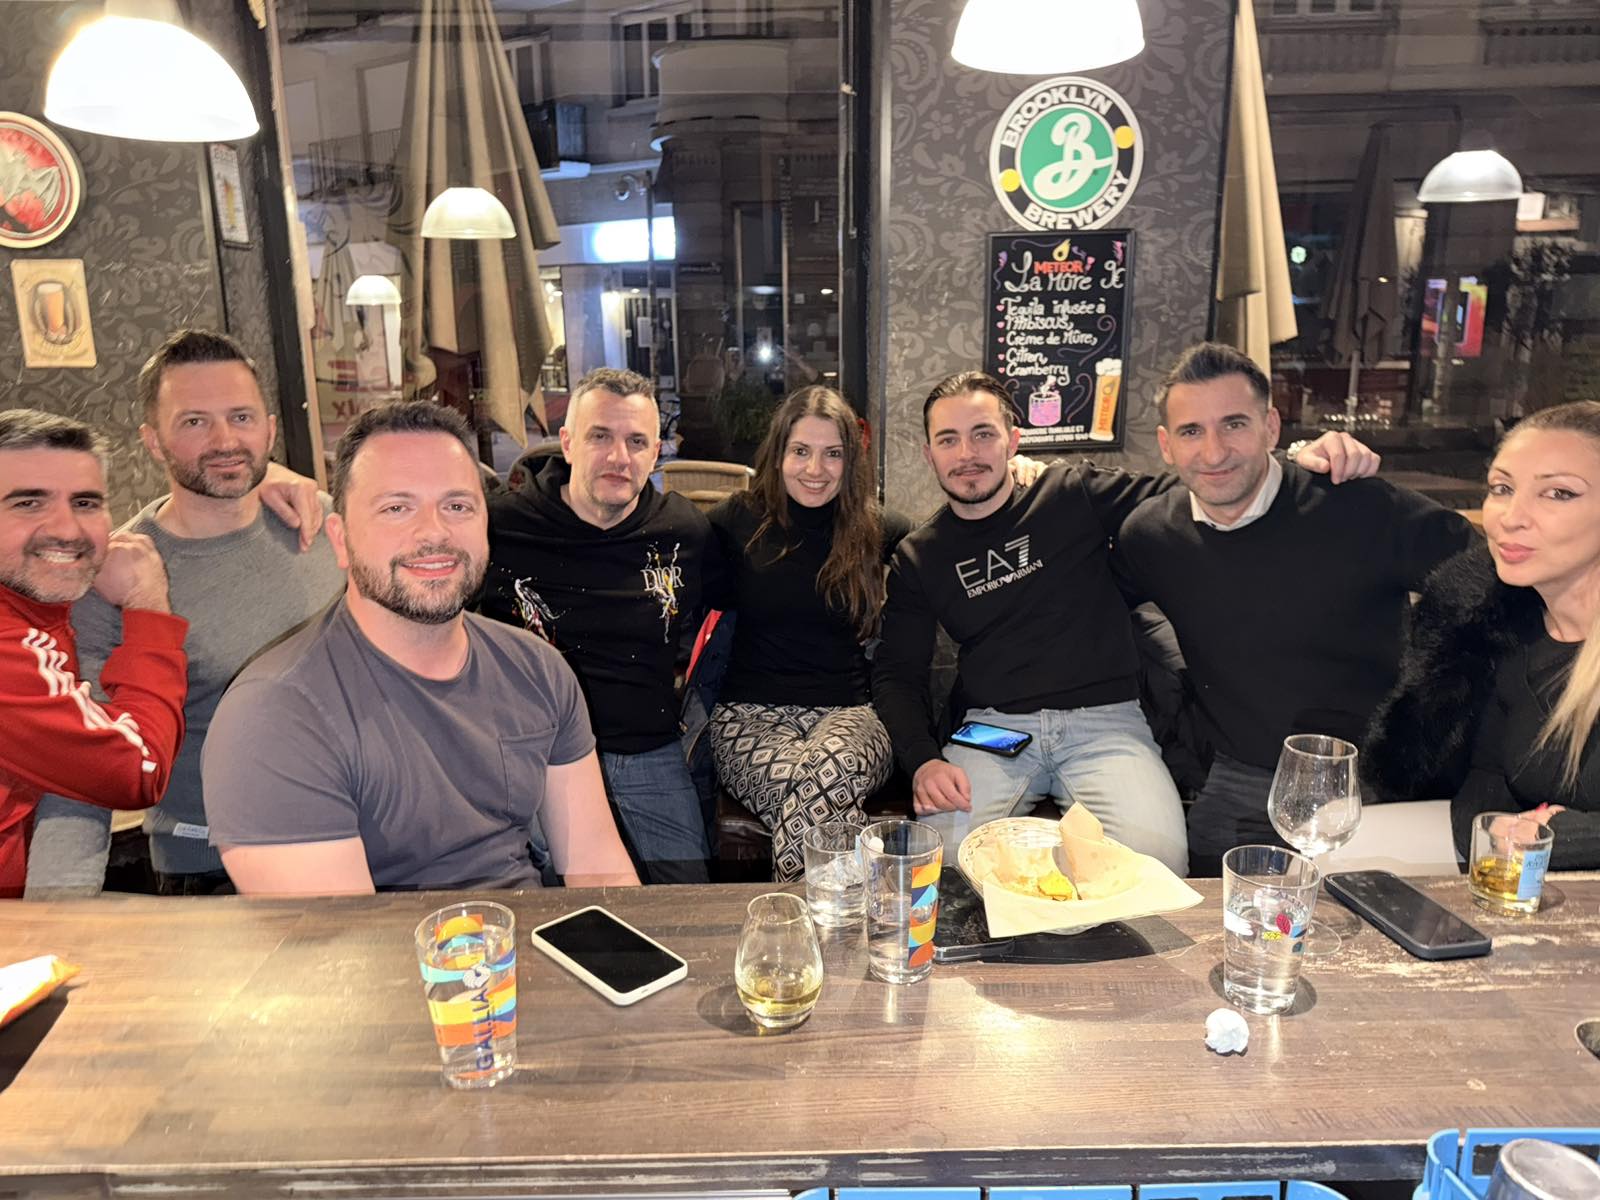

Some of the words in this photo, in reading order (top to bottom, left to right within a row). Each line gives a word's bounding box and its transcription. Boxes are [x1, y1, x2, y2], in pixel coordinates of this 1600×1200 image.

[1001, 86, 1113, 147] BROOKLYN
[1023, 169, 1129, 229] BREWERY
[1004, 250, 1043, 292] La
[1033, 261, 1084, 275] METEOR
[1001, 296, 1045, 318] Tequila
[1052, 300, 1096, 320] infusée
[1095, 297, 1106, 314] à
[1006, 331, 1045, 346] Crème
[1046, 331, 1061, 345] de
[1006, 361, 1071, 386] Cranberry
[955, 534, 1030, 590] EA7
[640, 566, 685, 591] DIOR
[966, 578, 1003, 599] EMPORIO
[471, 988, 495, 1071] GALLIA
